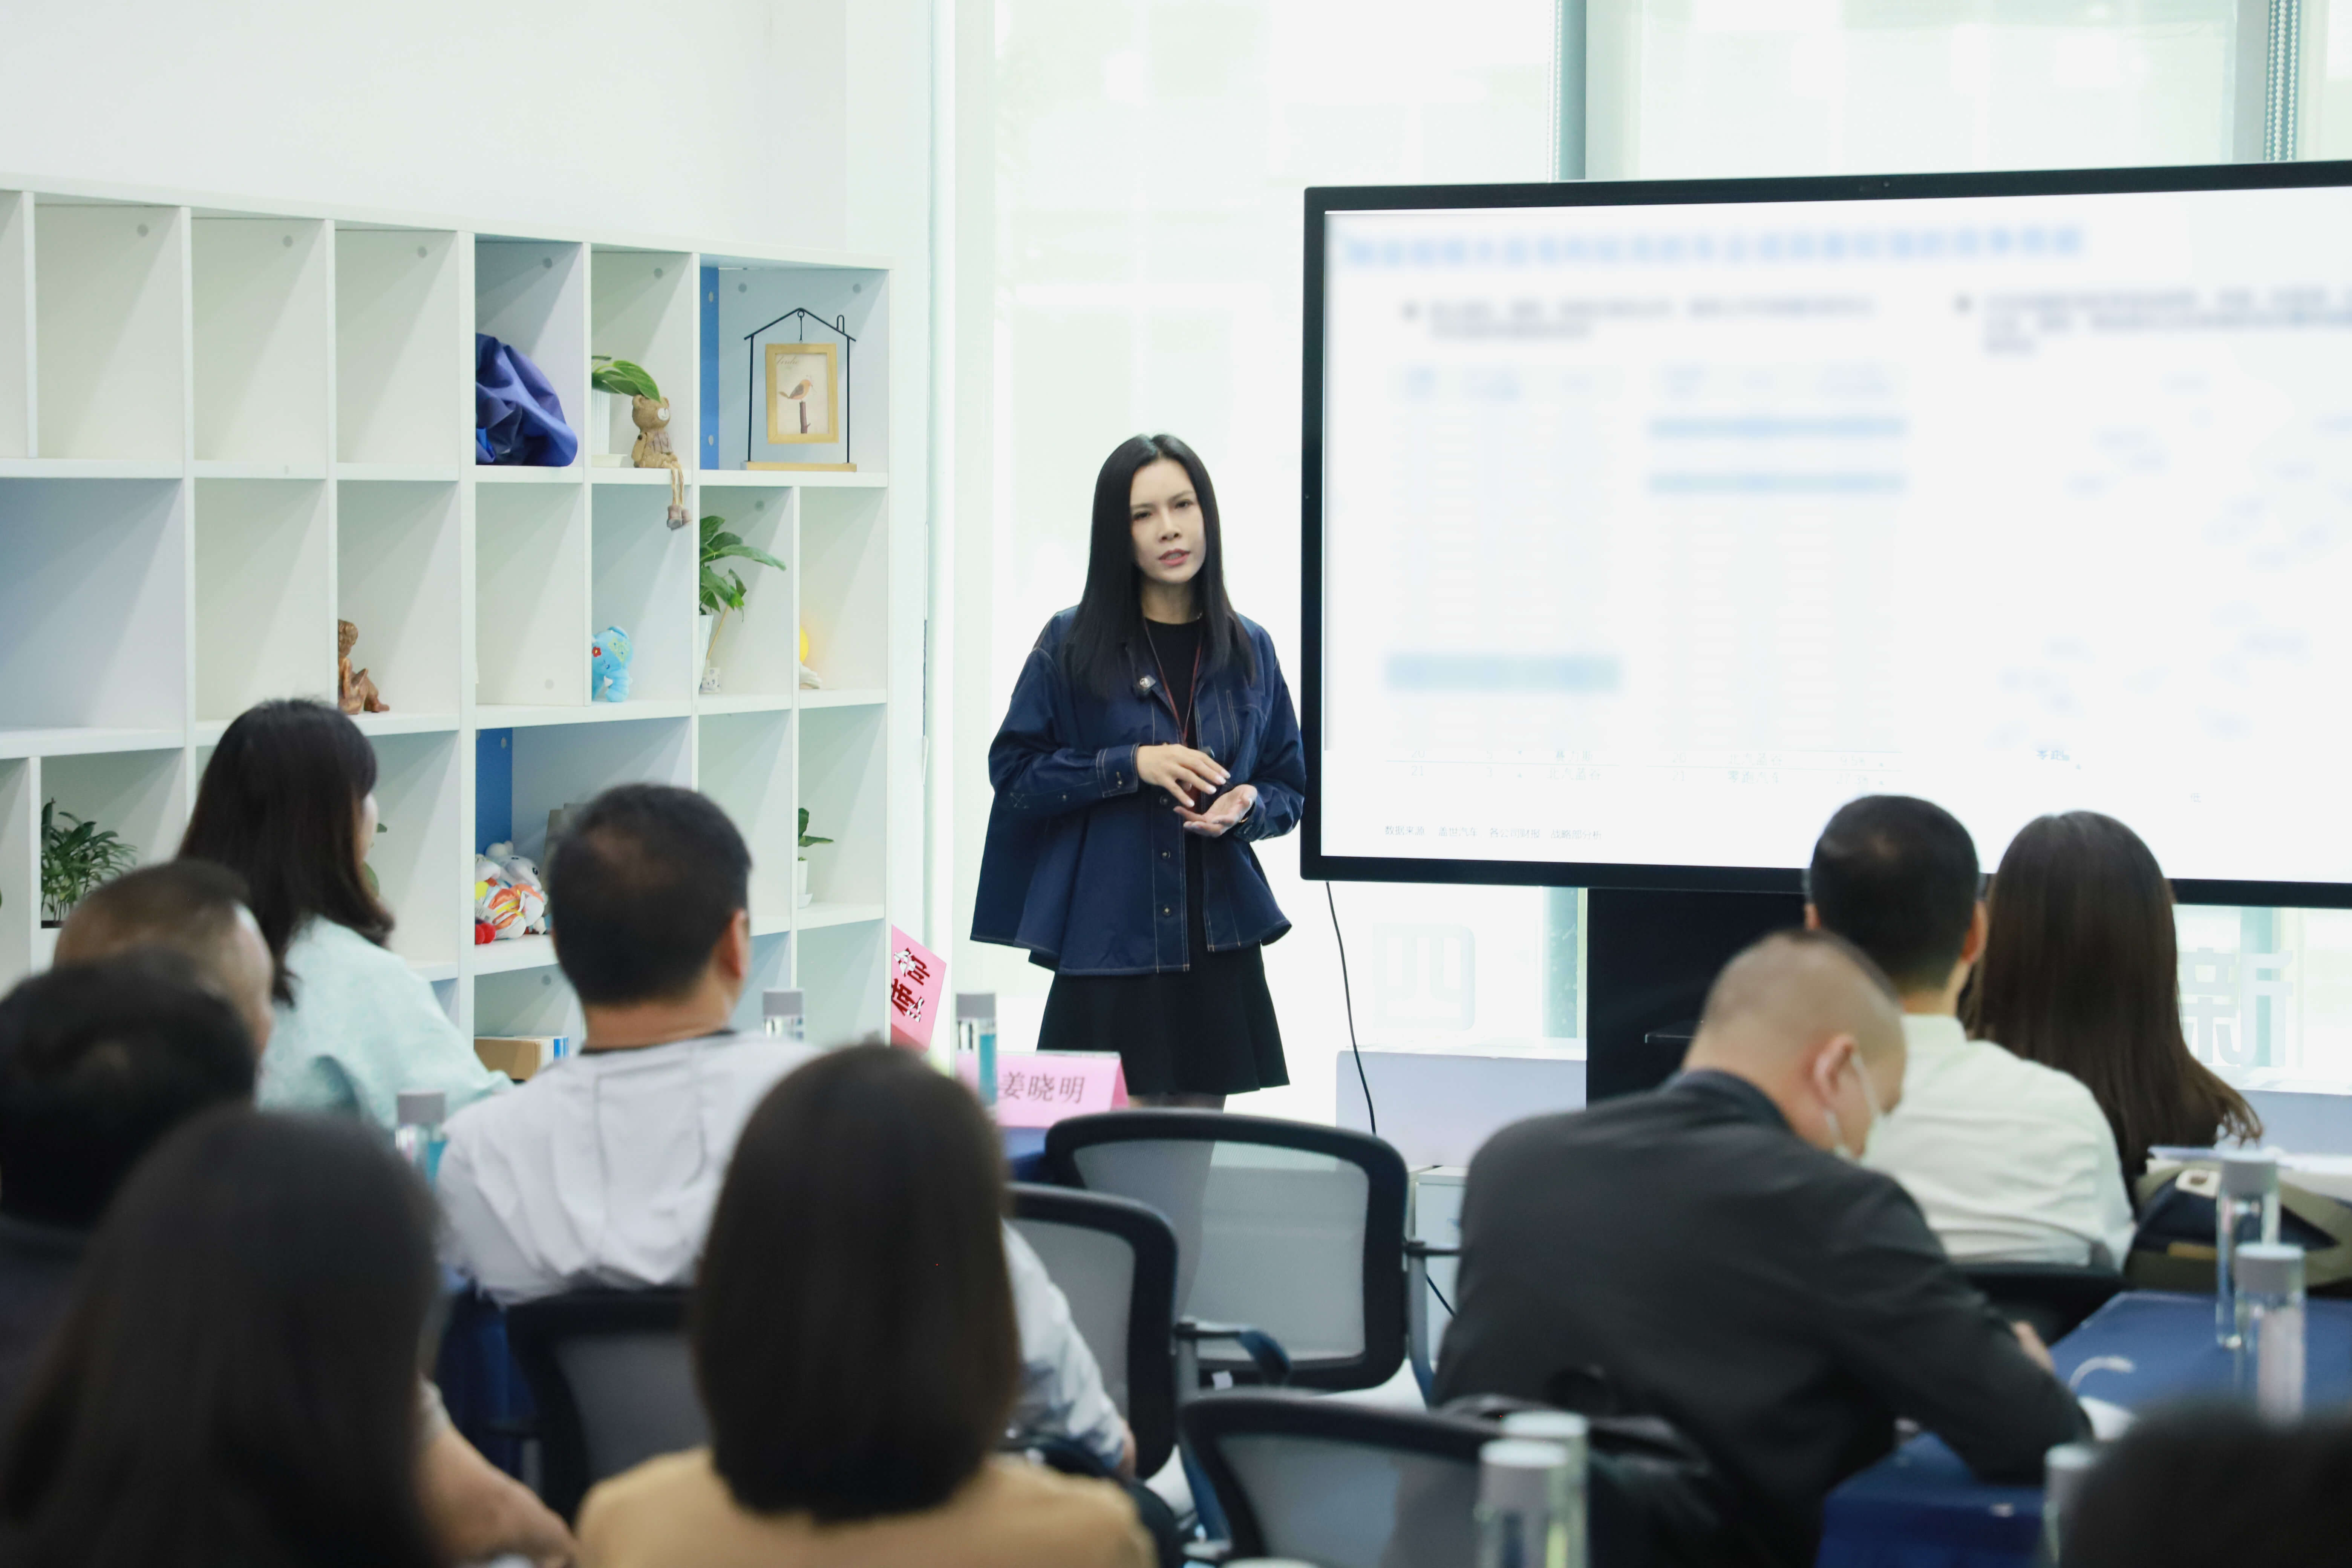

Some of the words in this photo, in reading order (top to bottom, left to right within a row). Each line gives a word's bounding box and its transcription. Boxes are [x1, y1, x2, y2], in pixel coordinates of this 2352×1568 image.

[1374, 923, 1475, 1031] 四
[2176, 947, 2293, 1067] 新
[999, 1071, 1085, 1104] 姜晓明
